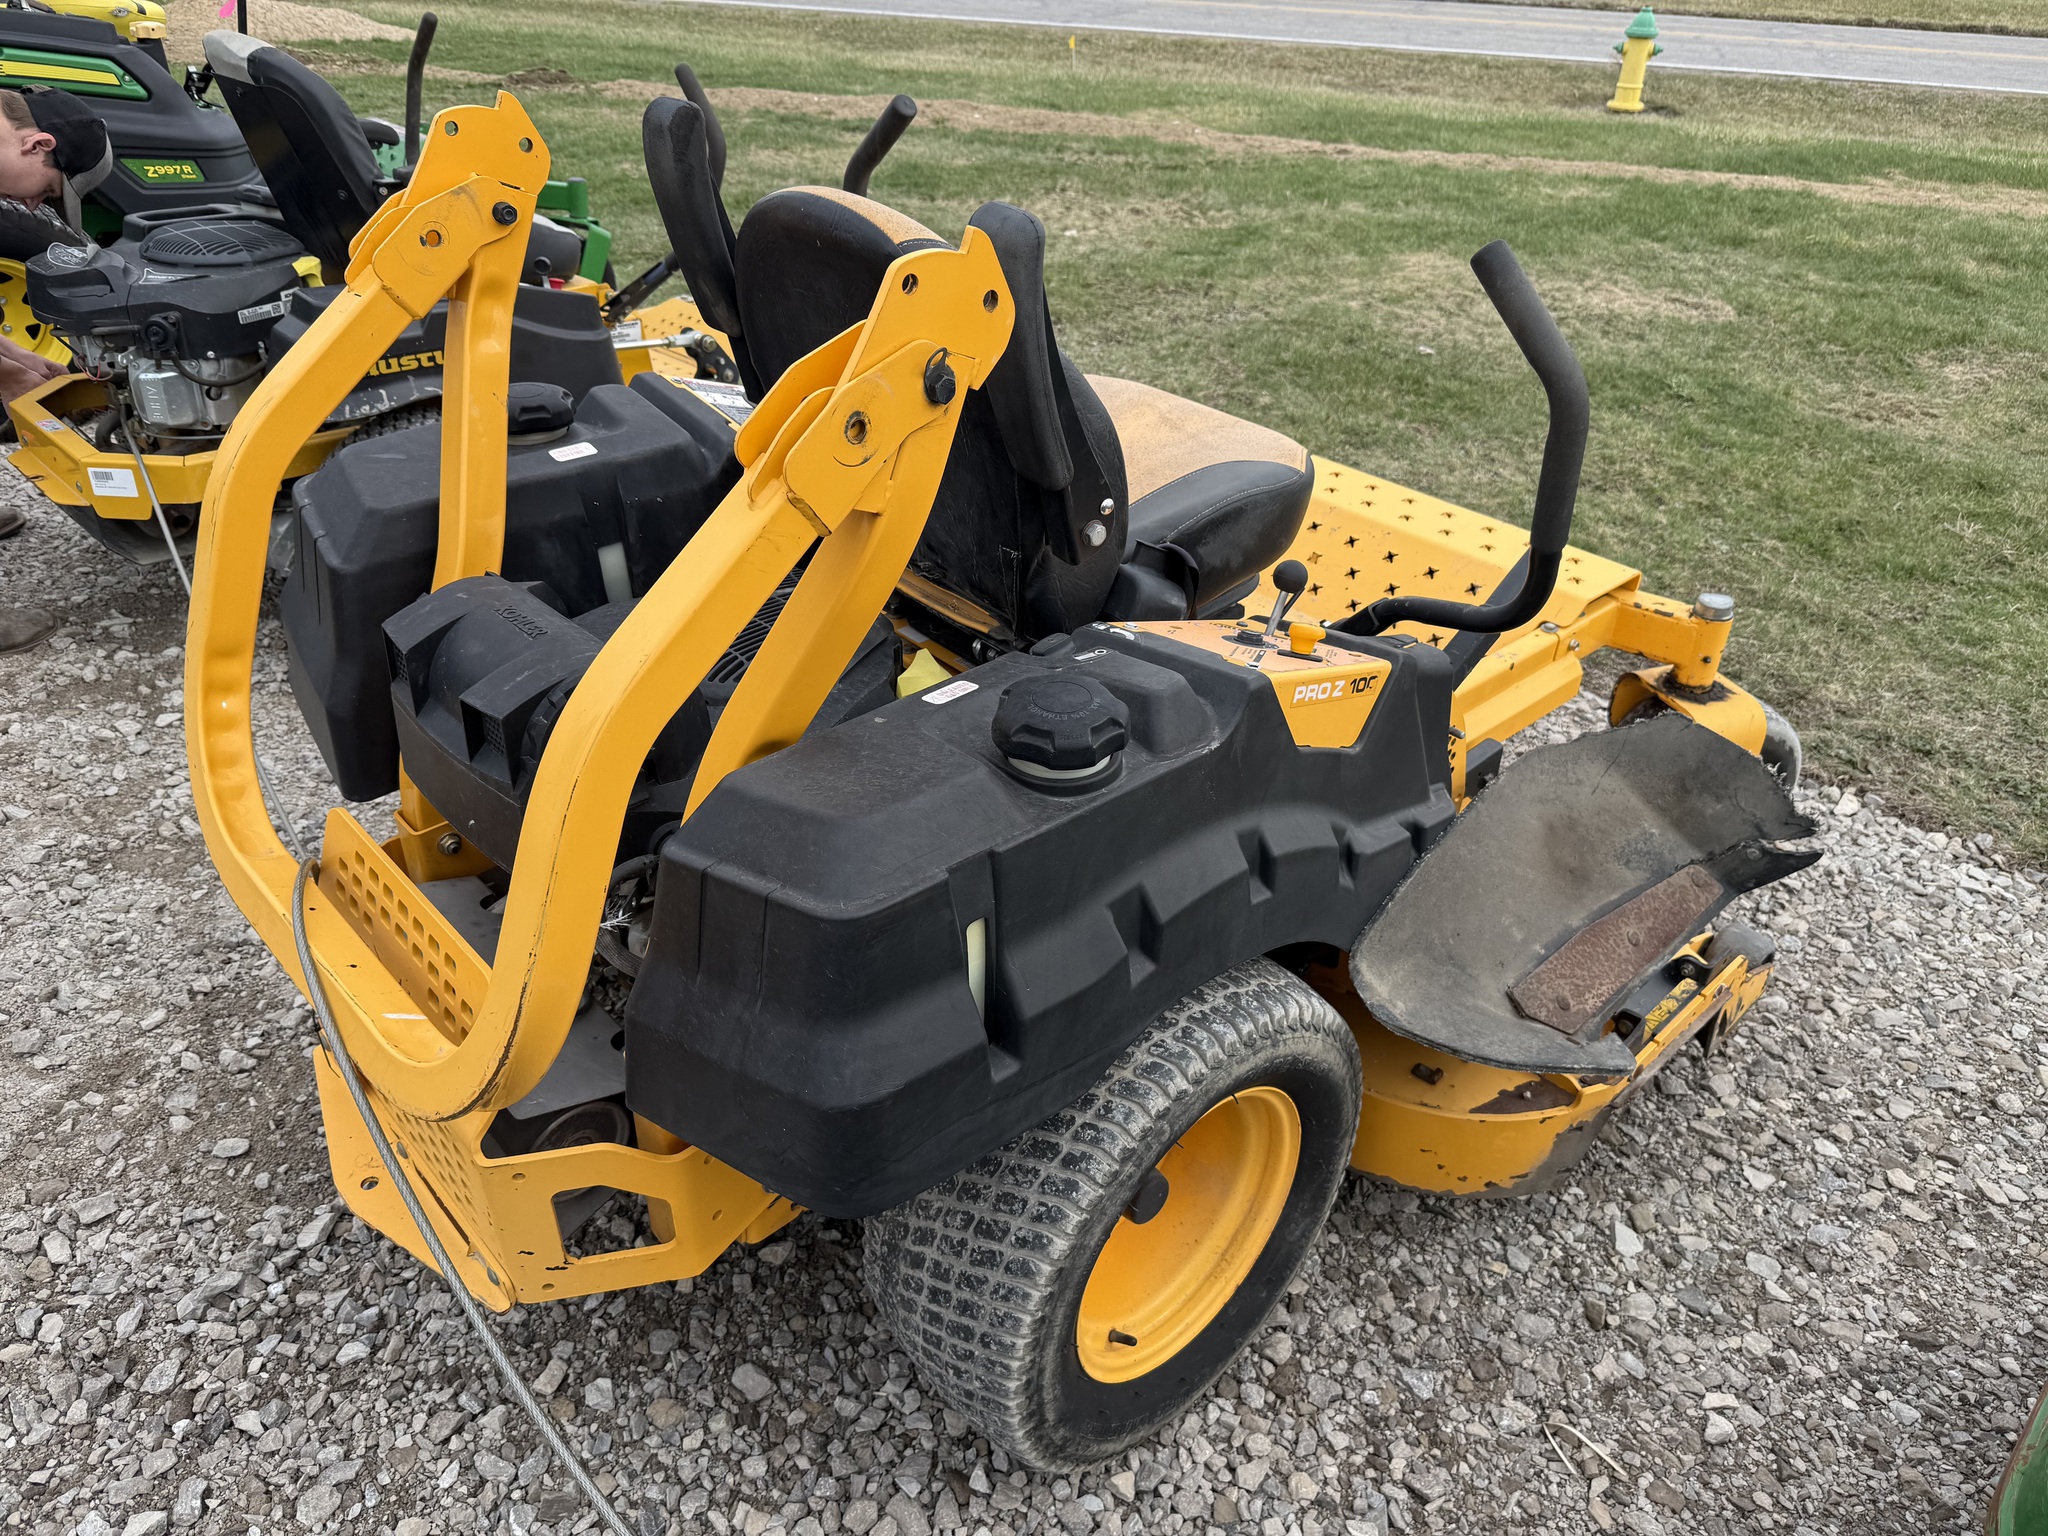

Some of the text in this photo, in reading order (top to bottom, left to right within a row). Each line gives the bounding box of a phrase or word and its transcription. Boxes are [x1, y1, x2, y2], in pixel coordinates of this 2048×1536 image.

[493, 605, 549, 641] KOHLER
[1292, 682, 1332, 704] PRO
[1331, 680, 1346, 698] Z
